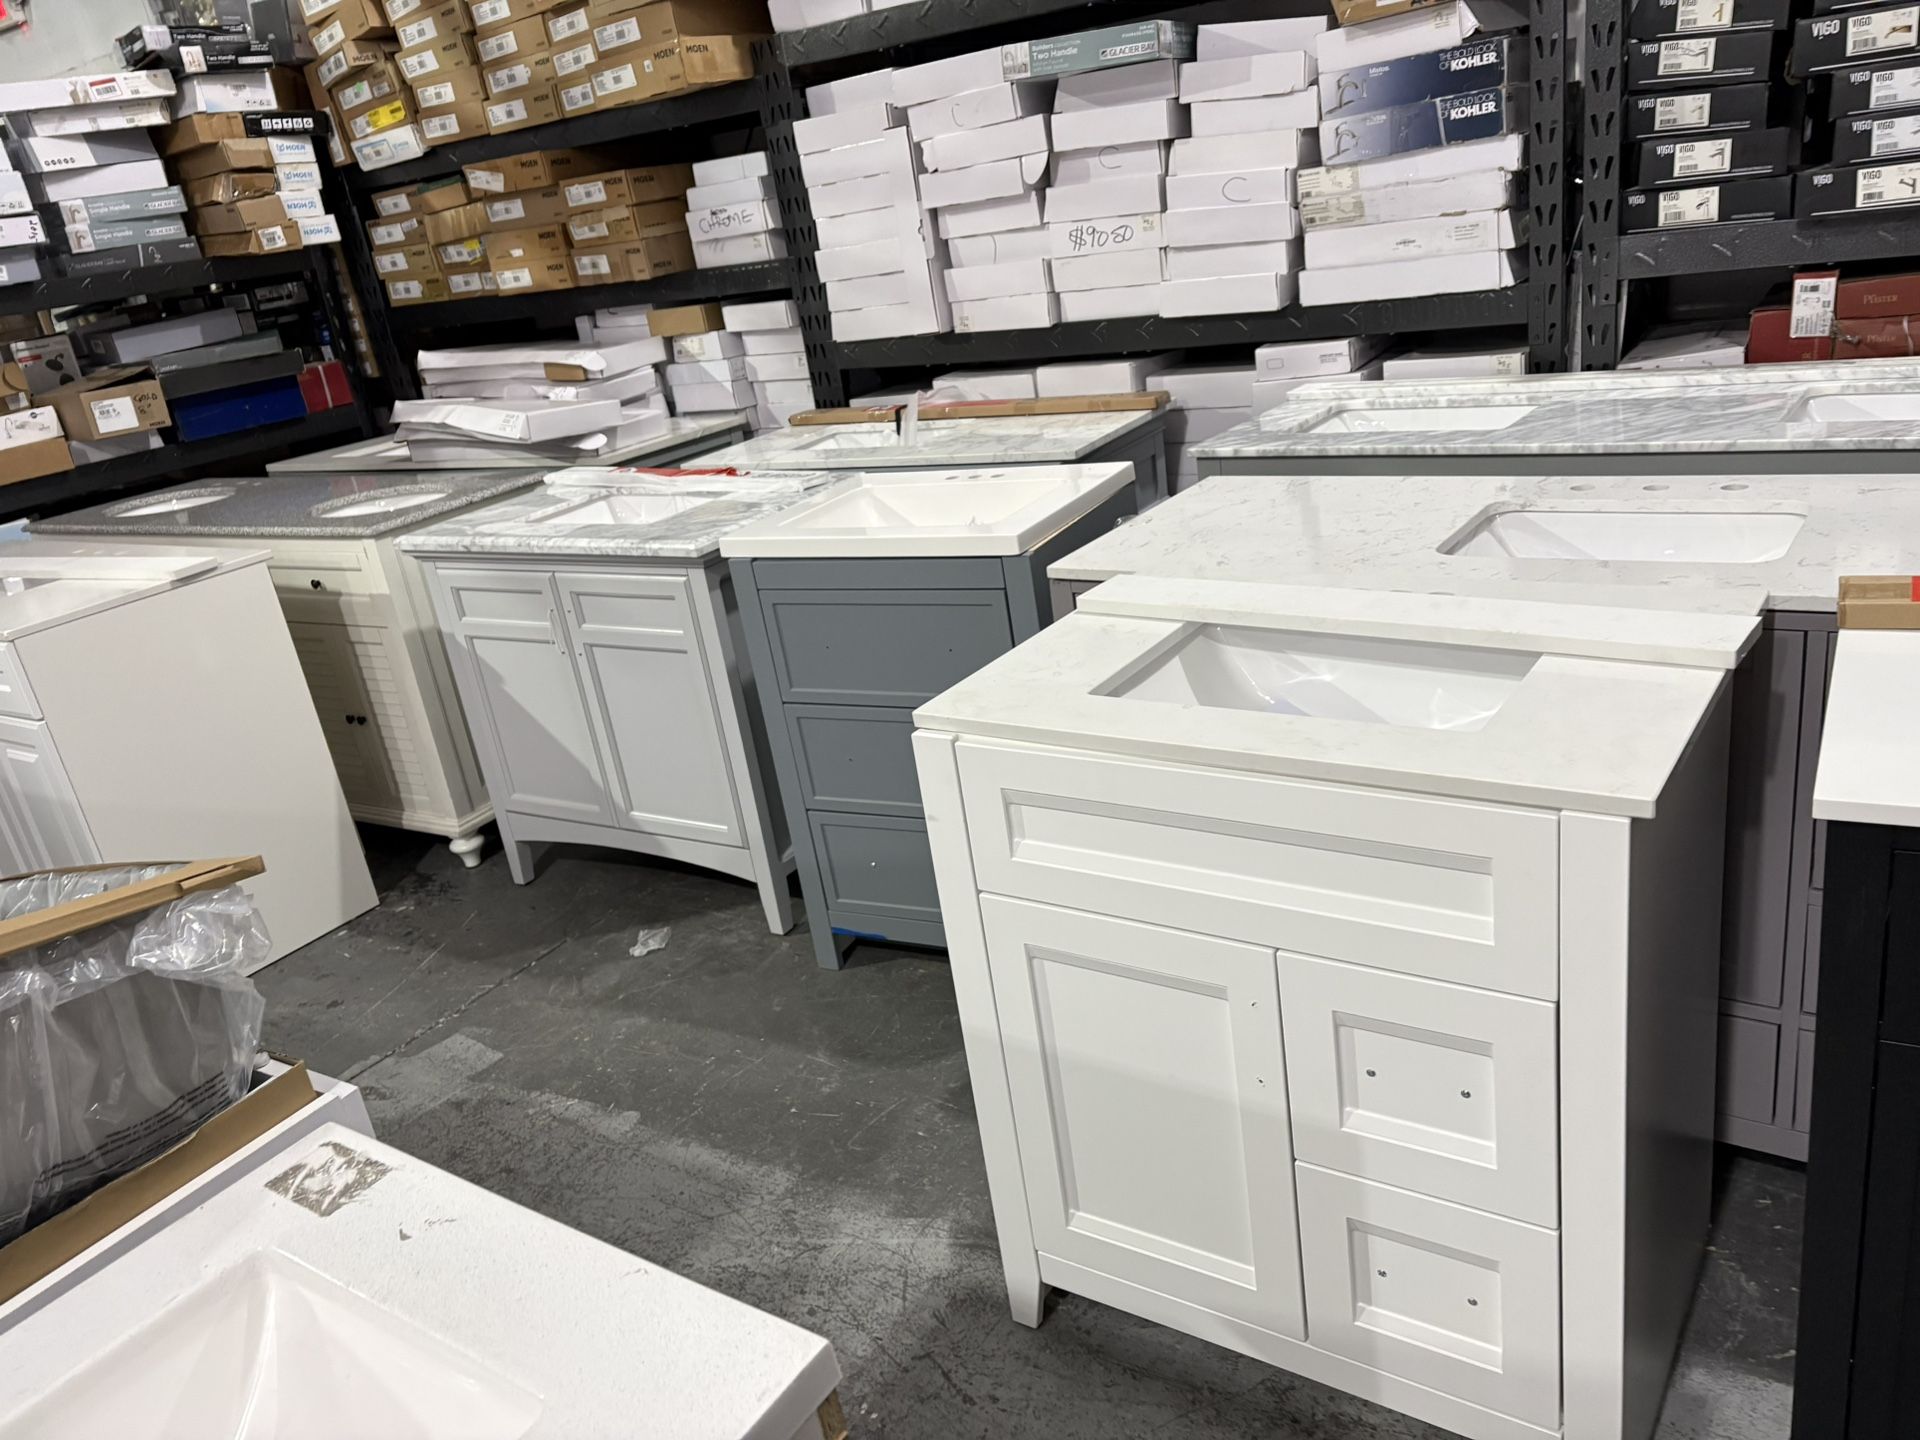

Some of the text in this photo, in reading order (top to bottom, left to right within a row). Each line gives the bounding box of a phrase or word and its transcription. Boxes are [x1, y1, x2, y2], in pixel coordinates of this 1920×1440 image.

[1852, 16, 1872, 28] VIGO
[1812, 20, 1840, 40] VIGO
[654, 48, 675, 61] MOEN
[686, 44, 708, 54] MOEN
[1032, 46, 1078, 60] Two Handle
[1108, 42, 1156, 57] GLACIER BAY
[1438, 42, 1497, 62] THE BOLD LOOK
[1438, 52, 1498, 72] OF KOHLER
[1850, 71, 1870, 85] VIGO
[1875, 72, 1894, 83] VIGO
[1453, 97, 1474, 108] BOLD
[1474, 92, 1496, 104] LOOK
[1450, 102, 1497, 120] KOHLER
[1852, 120, 1872, 134] VIGO
[520, 160, 538, 168] MOEN
[550, 157, 571, 167] MOEN
[604, 176, 624, 185] MOEN
[632, 175, 656, 184] MOEN
[1812, 174, 1833, 187] VIGO
[1862, 170, 1882, 180] VIGO
[699, 208, 754, 233] CHROME
[547, 263, 564, 272] MOEN
